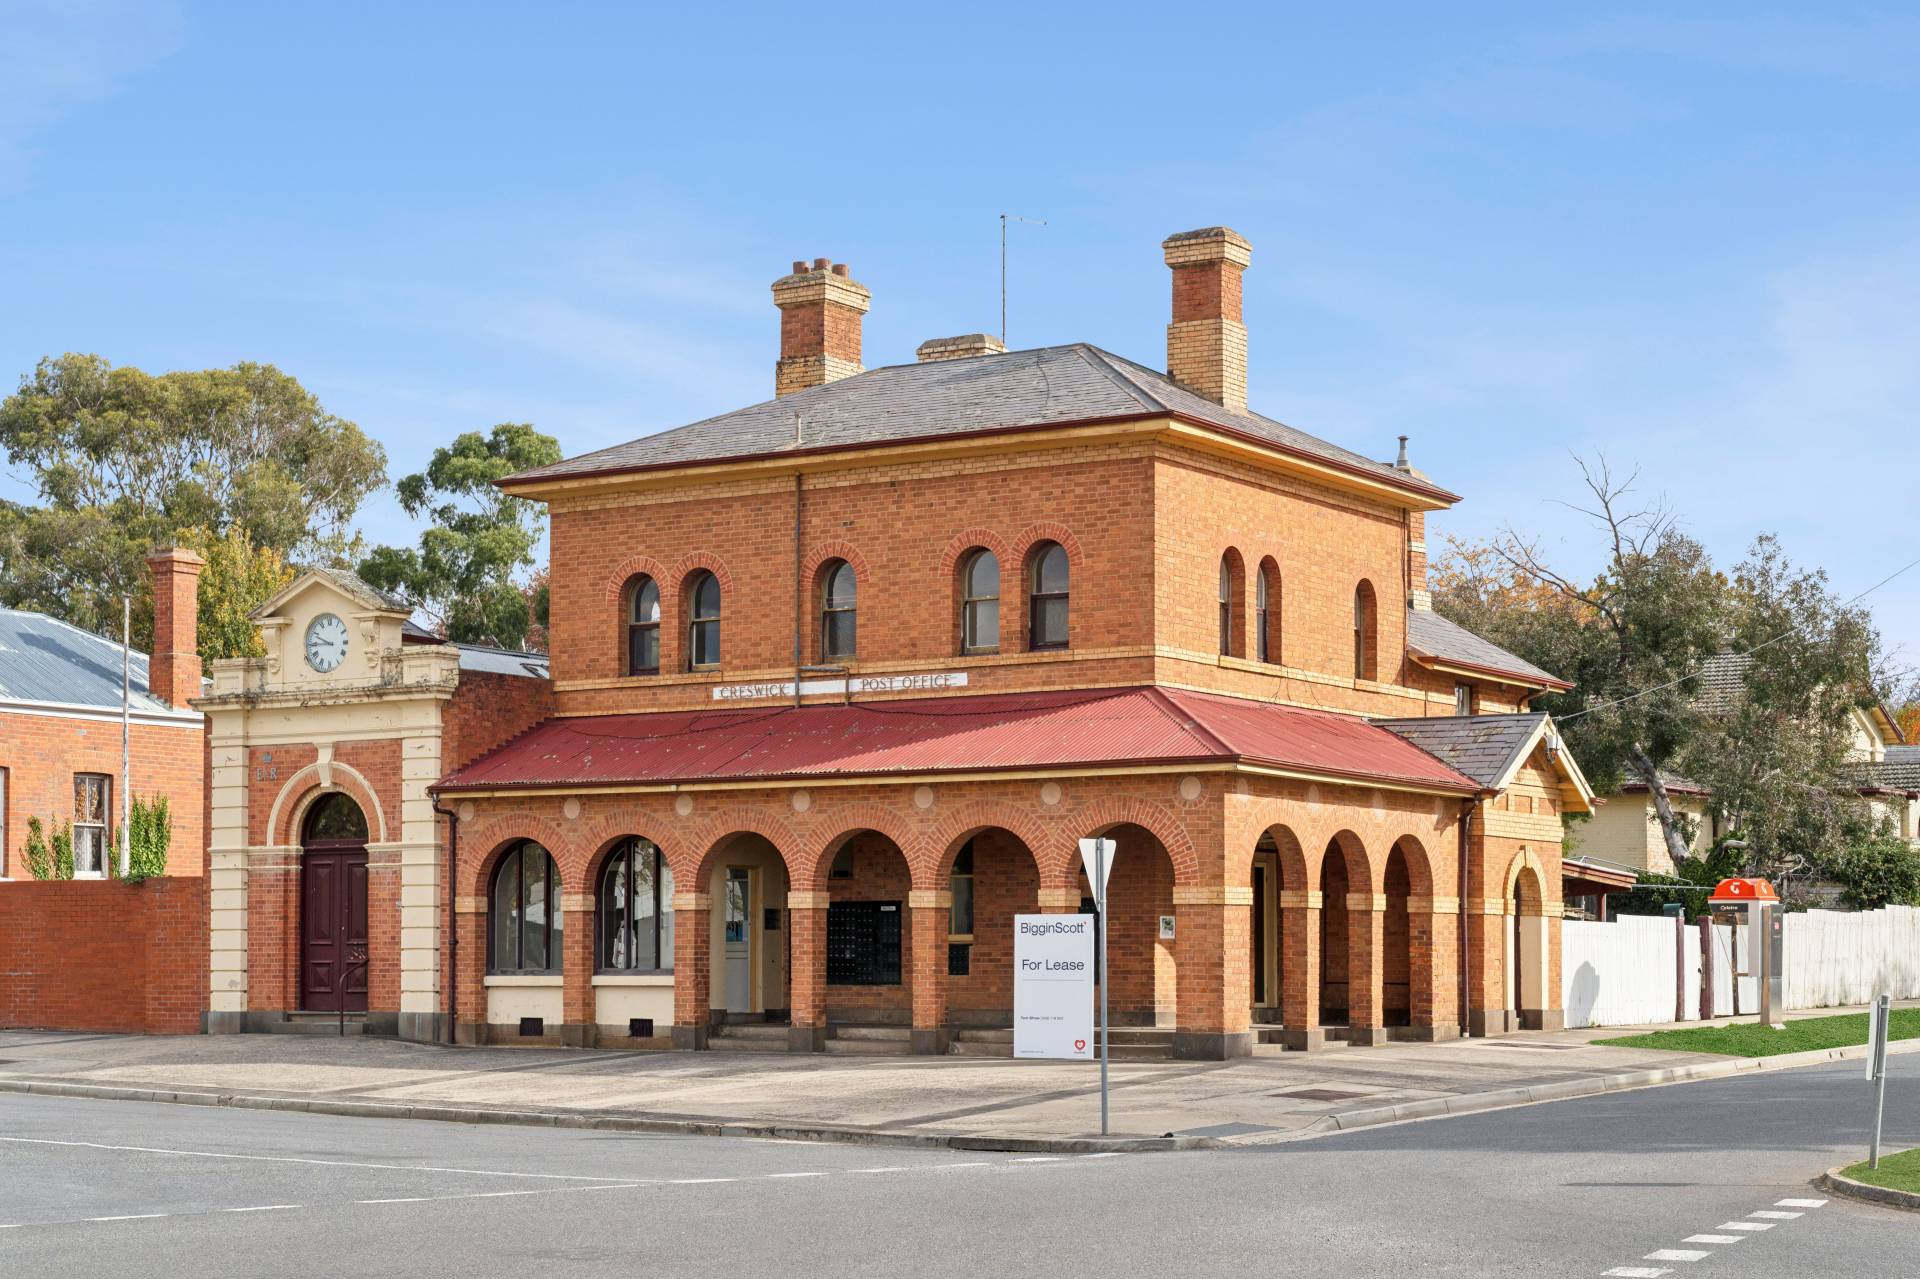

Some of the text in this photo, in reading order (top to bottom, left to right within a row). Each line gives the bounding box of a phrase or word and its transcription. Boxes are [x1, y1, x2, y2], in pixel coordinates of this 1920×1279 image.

[720, 674, 952, 699] CRESWICK POST OFFICE
[1020, 922, 1084, 936] BigginScott
[1022, 959, 1085, 971] For Lease
